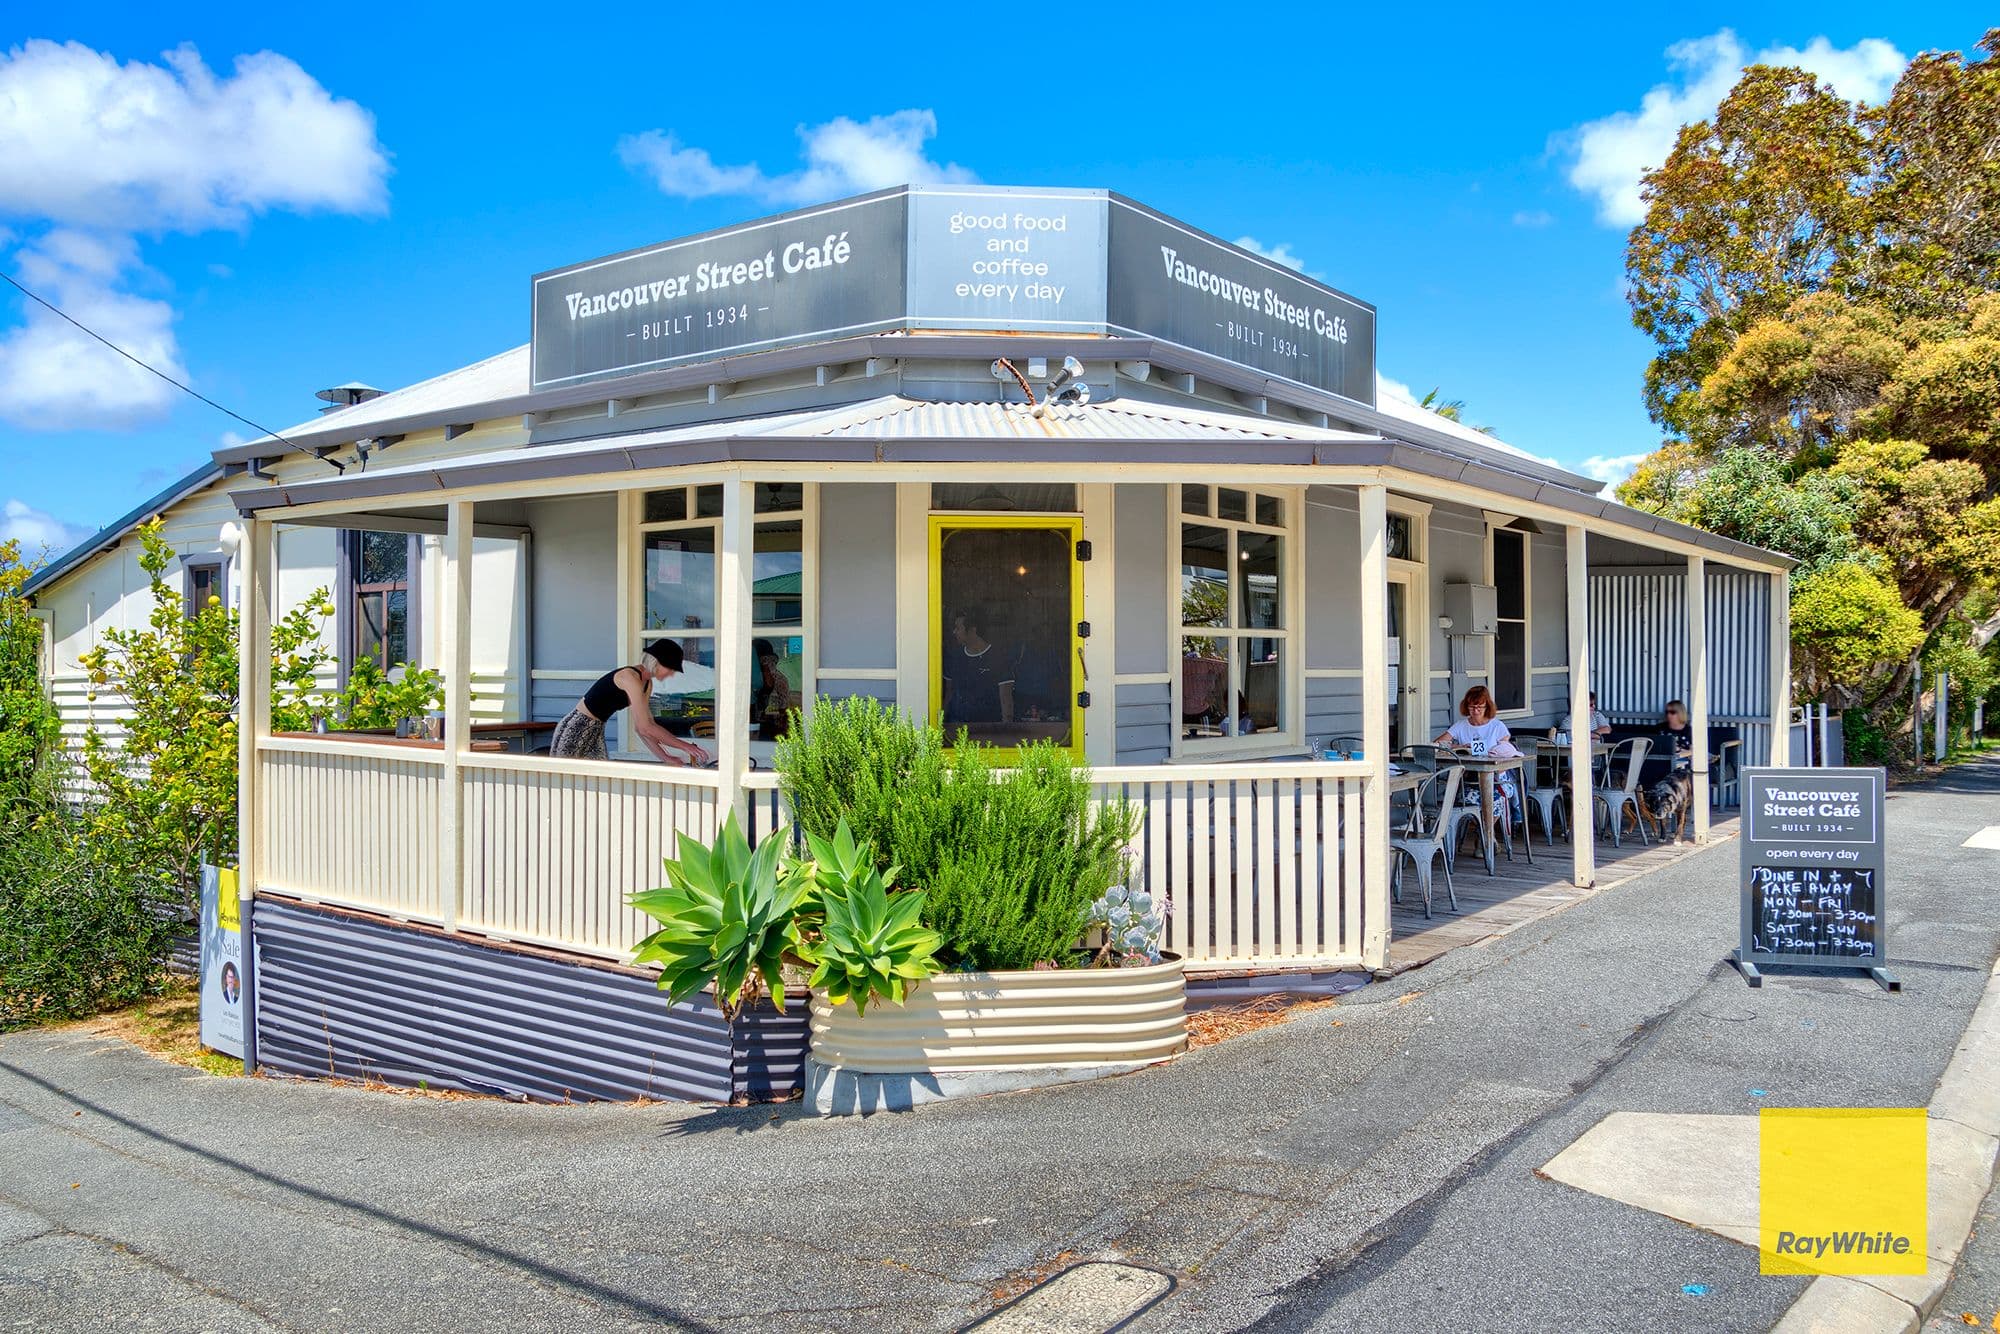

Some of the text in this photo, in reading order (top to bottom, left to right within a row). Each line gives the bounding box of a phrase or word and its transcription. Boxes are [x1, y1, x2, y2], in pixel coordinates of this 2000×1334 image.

[949, 211, 1067, 234] good food
[986, 237, 1030, 253] and
[972, 258, 1049, 276] coffee
[565, 231, 851, 321] Vancouver Street Café
[955, 282, 1065, 304] every day
[1161, 245, 1348, 345] Vancouver Street Café
[642, 303, 749, 340] BUILT 1934
[1228, 322, 1299, 359] BUILT 1934
[1473, 742, 1485, 752] 23
[1765, 787, 1860, 802] Vancouver
[1763, 803, 1861, 818] Street Café
[1781, 823, 1843, 832] BUILT 1934
[1766, 849, 1859, 861] open every day
[1761, 868, 1795, 882] DINE
[1803, 870, 1820, 882] IN
[1761, 882, 1852, 895] TAKE AWAY
[1764, 897, 1797, 908] MON
[1818, 896, 1842, 909] FRI
[1766, 922, 1801, 933] SAT
[1826, 924, 1856, 935] SUN
